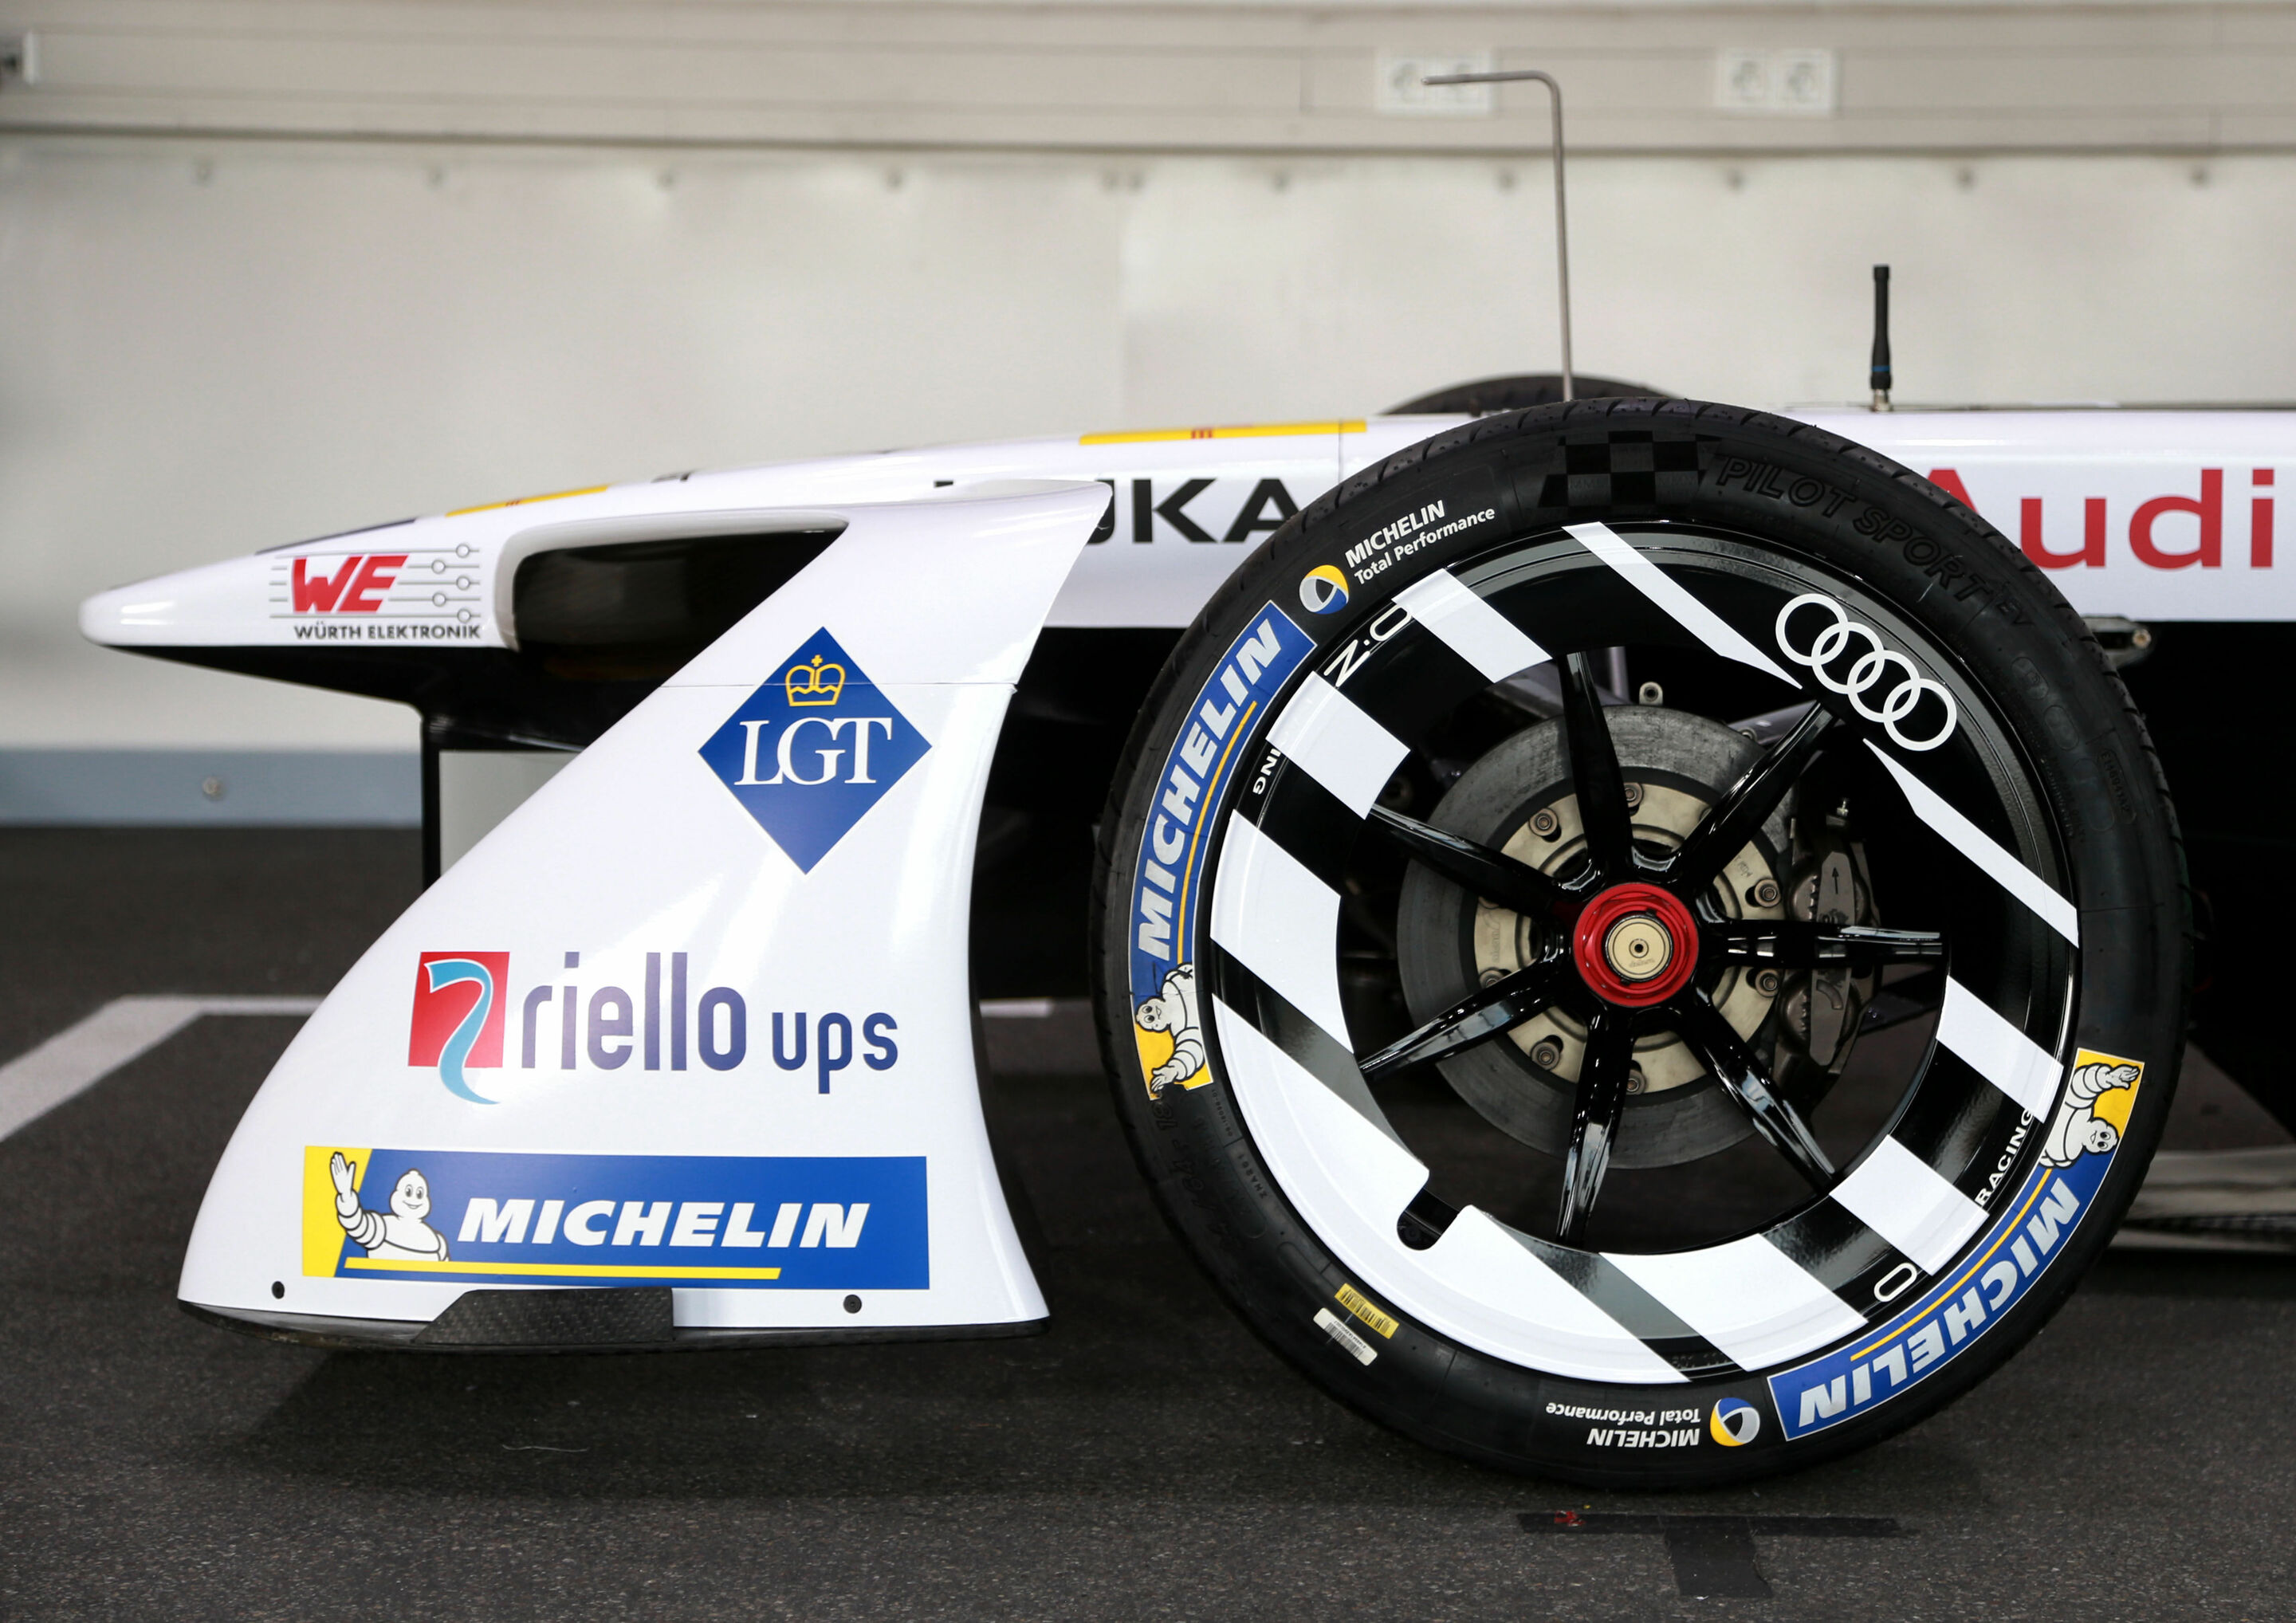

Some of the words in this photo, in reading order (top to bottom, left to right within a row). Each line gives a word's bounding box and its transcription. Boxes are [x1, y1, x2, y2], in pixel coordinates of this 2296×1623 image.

[1344, 499, 1446, 568] MICHELIN
[1354, 552, 1393, 585] Total
[1393, 508, 1496, 562] Performance
[1716, 456, 1857, 518] PILOT
[1853, 505, 1991, 602] SPORT
[292, 555, 409, 614] WE
[293, 620, 362, 639] WÜRTH
[368, 624, 480, 639] ELEKTRONIK
[733, 717, 893, 786] LGT
[1137, 619, 1282, 961] MICHELIN
[521, 951, 747, 1071] riello
[771, 1011, 898, 1095] ups
[1974, 1108, 2035, 1207] RACING
[457, 1197, 871, 1249] MICHELIN
[1799, 1177, 2081, 1428] MICHELIN
[1545, 1401, 1656, 1426] Performance
[1586, 1427, 1701, 1448] MICHELIN
[1658, 1408, 1701, 1426] Total
